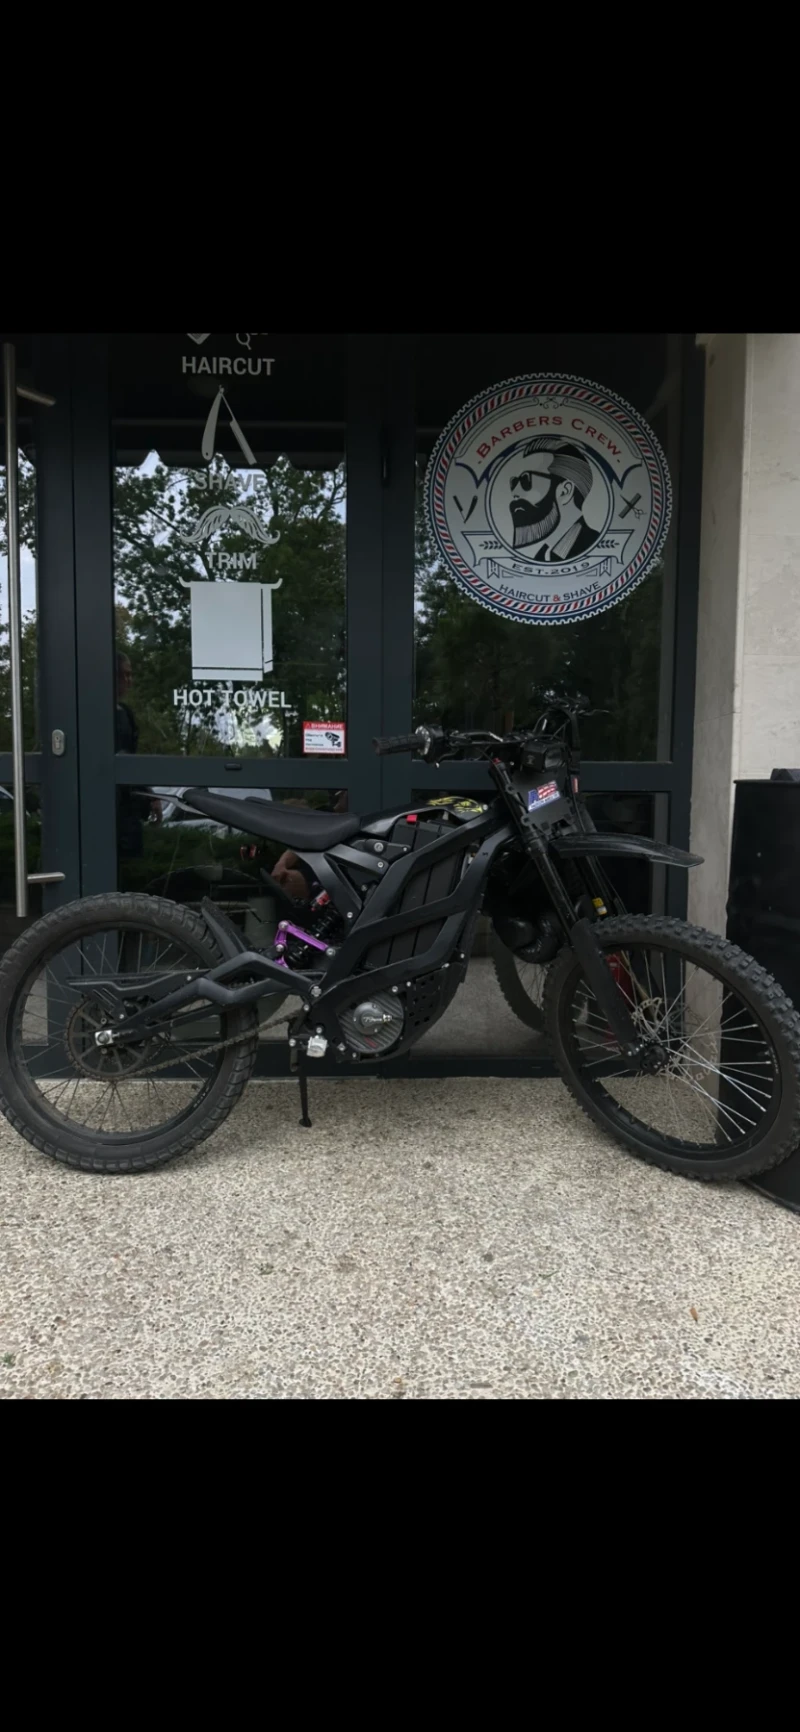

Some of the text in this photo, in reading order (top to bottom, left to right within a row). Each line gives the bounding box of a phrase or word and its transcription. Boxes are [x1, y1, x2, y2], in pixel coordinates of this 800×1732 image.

[182, 356, 275, 376] HAIRCUT
[194, 472, 266, 492] SHAVE
[204, 551, 258, 570] TRIM
[499, 583, 551, 603] HAIRCUT
[563, 581, 602, 601] SHAVE
[173, 689, 292, 709] HOT TOWEL
